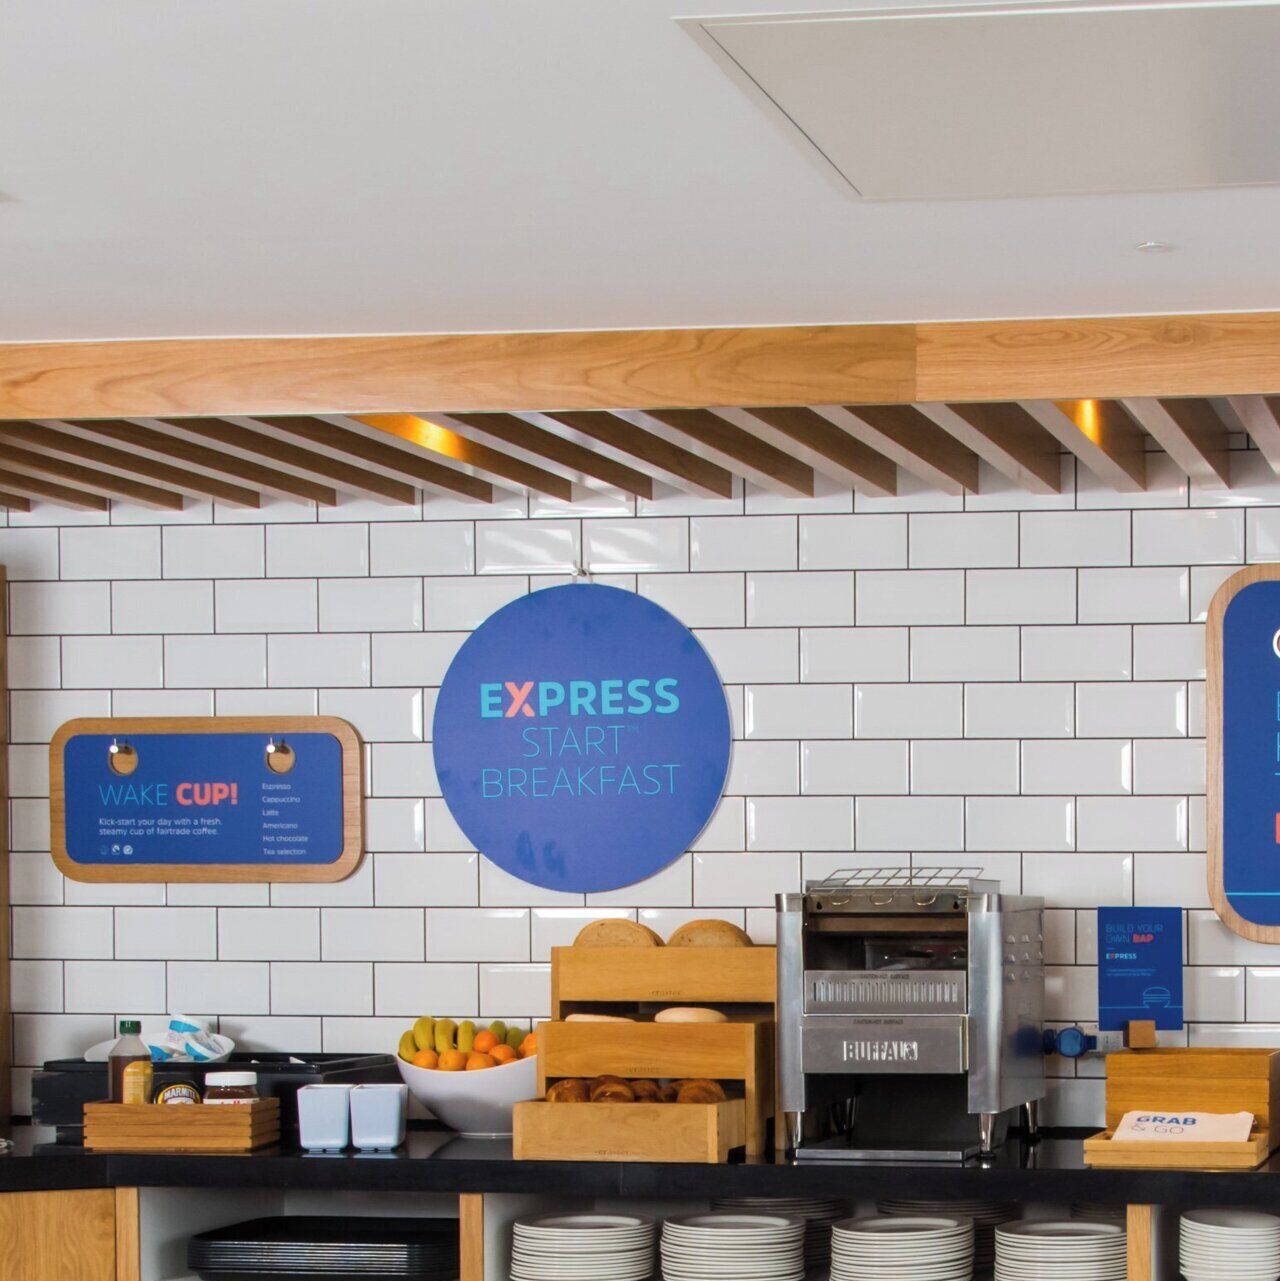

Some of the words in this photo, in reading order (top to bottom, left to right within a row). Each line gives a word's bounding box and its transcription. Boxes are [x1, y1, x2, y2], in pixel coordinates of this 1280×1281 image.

[479, 677, 681, 718] EXPRESS
[481, 763, 681, 799] BREAKFAST
[98, 783, 169, 806] WAKE
[175, 782, 238, 806] CUP!
[137, 819, 155, 827] your
[157, 818, 172, 827] day
[173, 818, 192, 826] with
[98, 828, 127, 836] steamy
[129, 828, 145, 836] cup
[146, 827, 155, 835] of
[1132, 933, 1154, 943] BAP
[843, 1040, 918, 1061] BUFFALO
[163, 1086, 197, 1100] MARMITE
[1136, 1115, 1198, 1126] GRAB
[1131, 1124, 1145, 1132] &
[1154, 1125, 1185, 1135] GO
